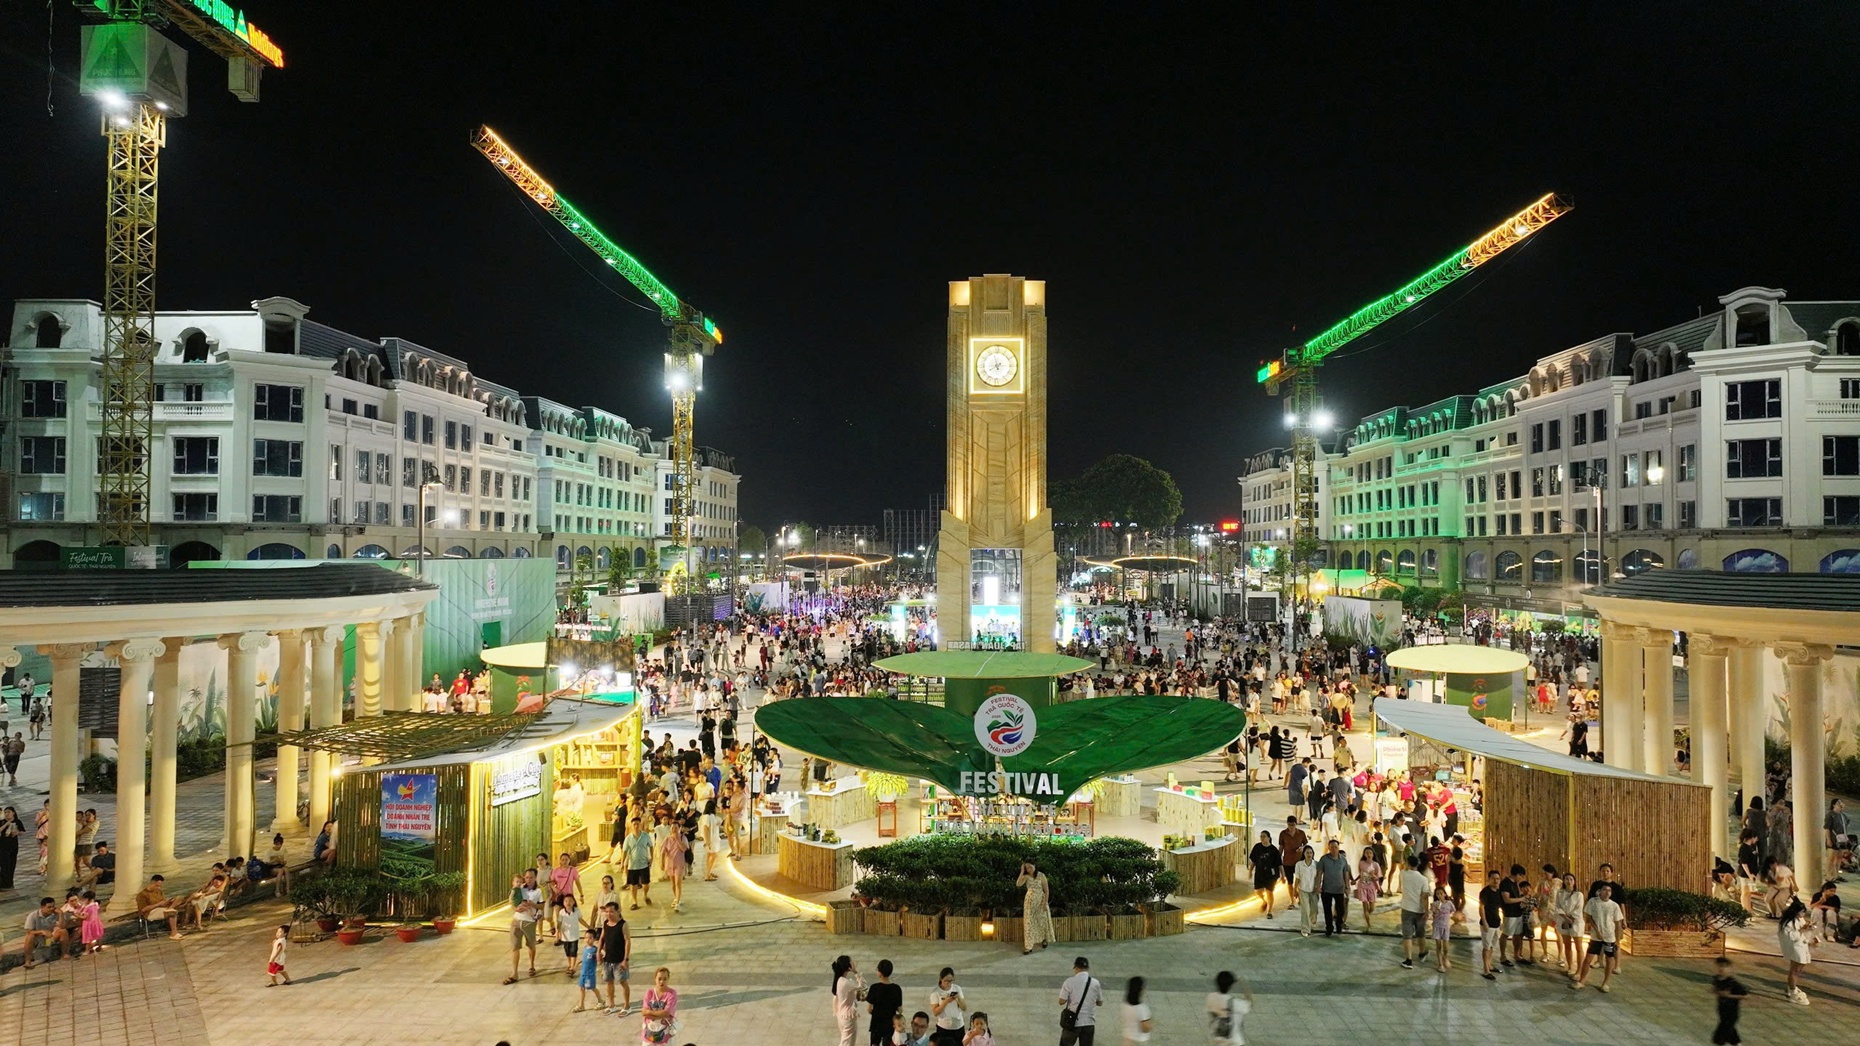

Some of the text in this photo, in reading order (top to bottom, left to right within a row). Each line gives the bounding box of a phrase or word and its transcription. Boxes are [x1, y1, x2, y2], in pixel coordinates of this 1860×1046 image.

[69, 552, 99, 563] Festival
[990, 696, 1018, 704] FESTIVAL
[985, 705, 997, 715] TRÀ
[1016, 705, 1025, 714] TẾ
[960, 771, 1064, 795] FESTIVAL
[395, 803, 412, 811] DOANH
[386, 812, 405, 820] DOANH
[410, 822, 432, 831] NGUYÊN
